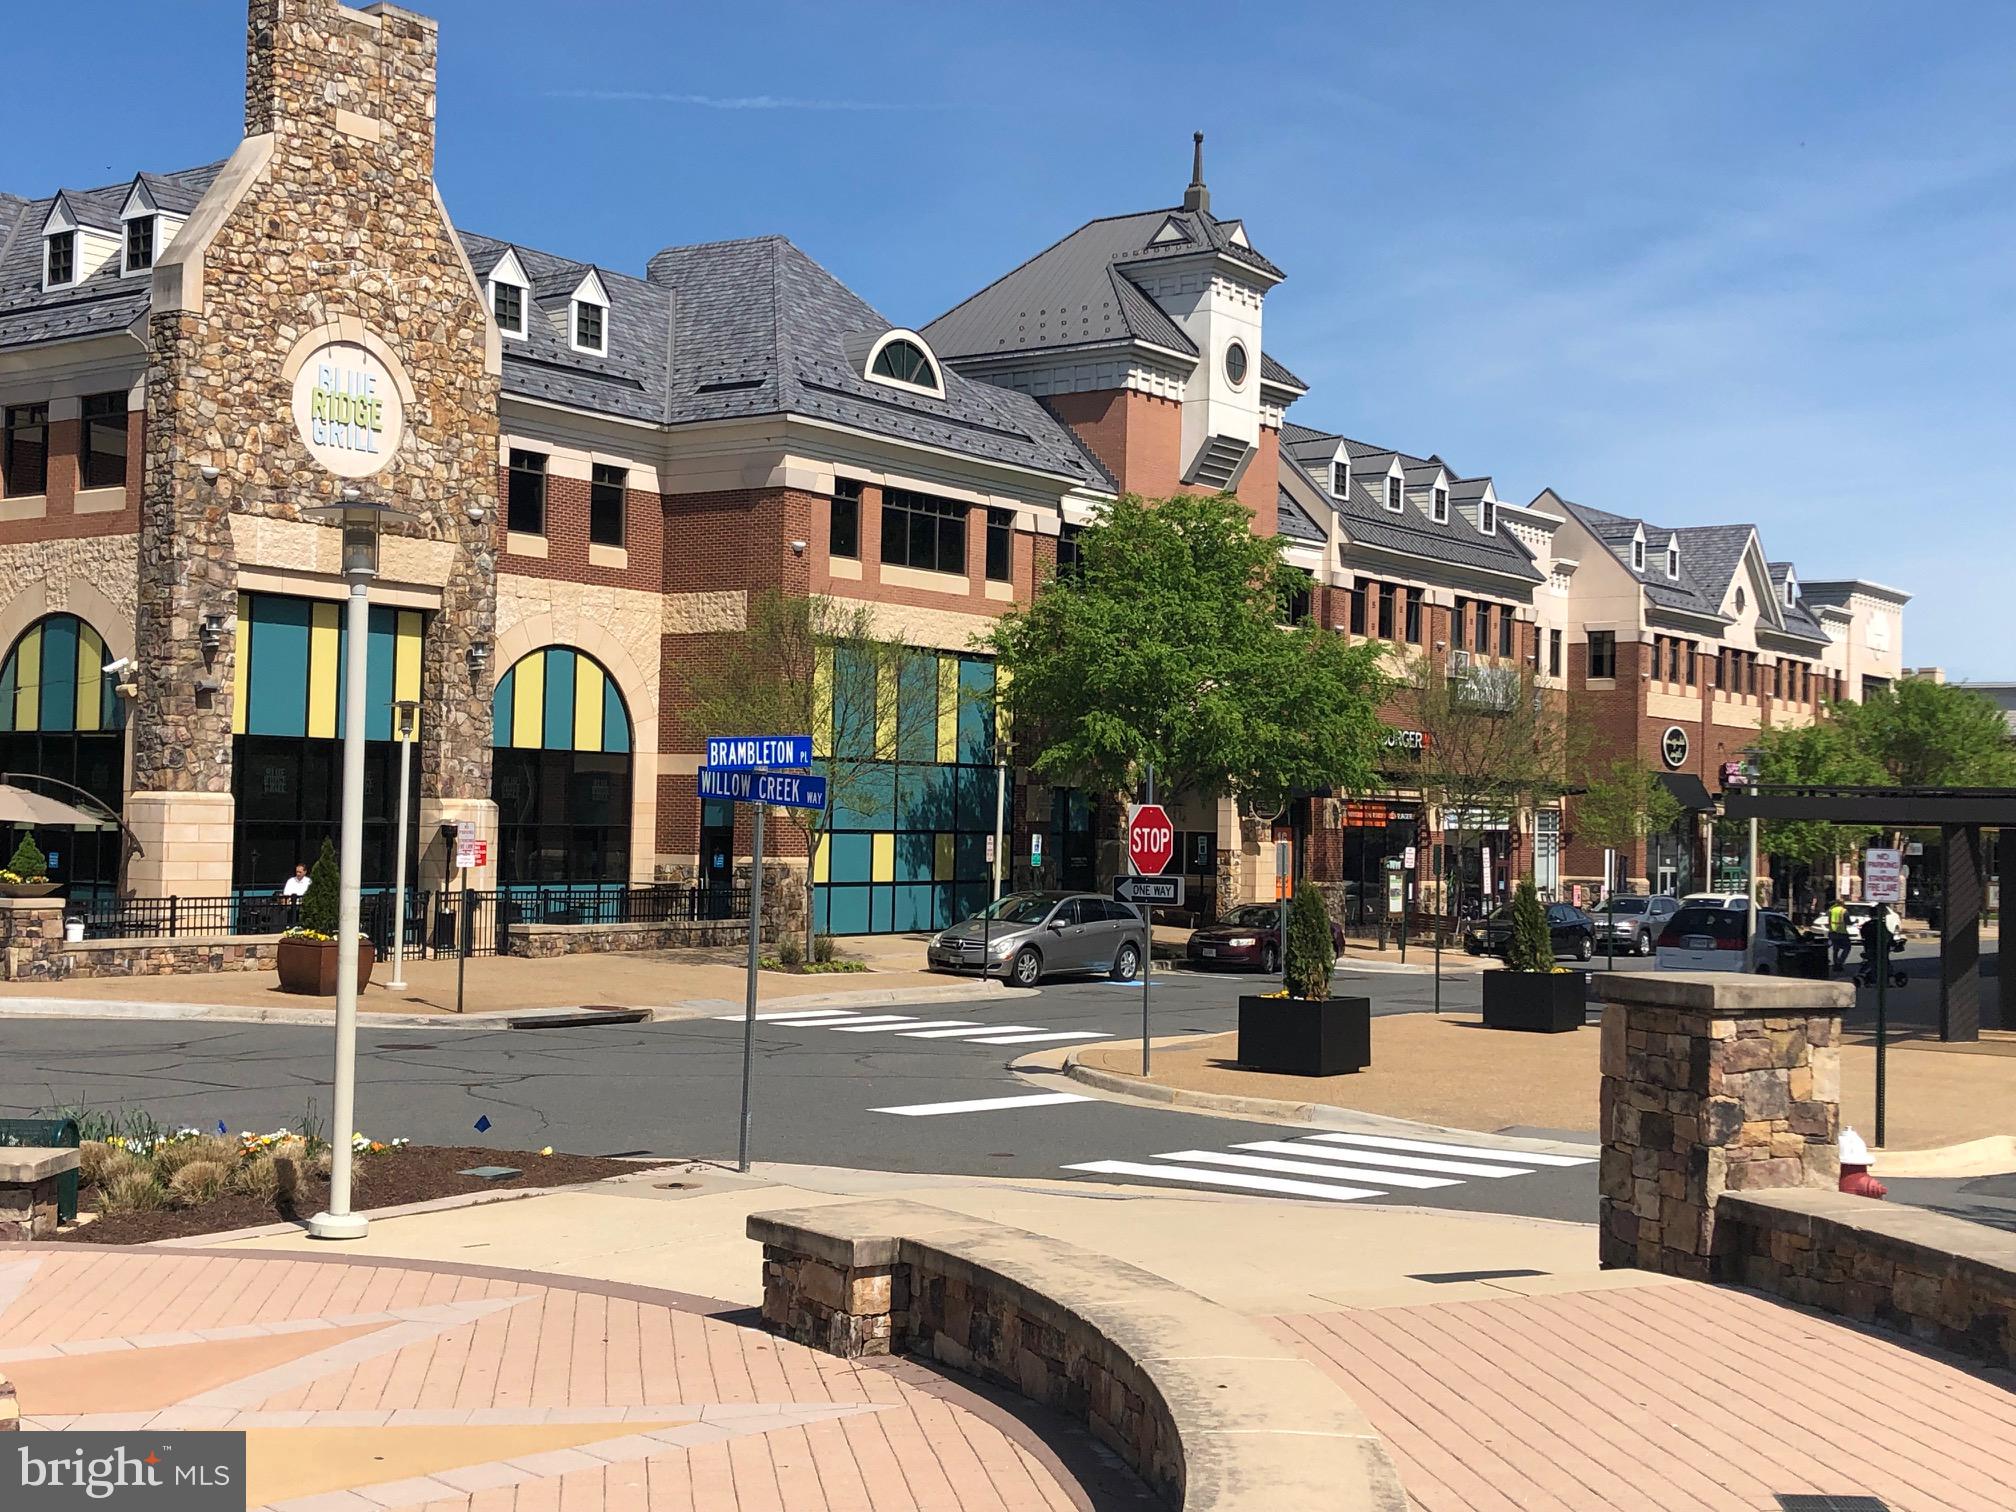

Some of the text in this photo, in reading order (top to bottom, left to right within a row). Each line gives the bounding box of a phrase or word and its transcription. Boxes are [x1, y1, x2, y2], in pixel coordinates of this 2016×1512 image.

[318, 364, 377, 403] BLUE
[312, 387, 383, 433] RIDGE
[312, 417, 379, 454] GRILL
[710, 740, 808, 766] BRAMBLETON PL
[701, 770, 823, 804] WILLOW CREEK WAY
[1132, 827, 1170, 853] STOP
[1868, 861, 1898, 869] PARKING
[1133, 885, 1172, 896] ONE WAY
[1868, 883, 1898, 892] FIRE LANE
